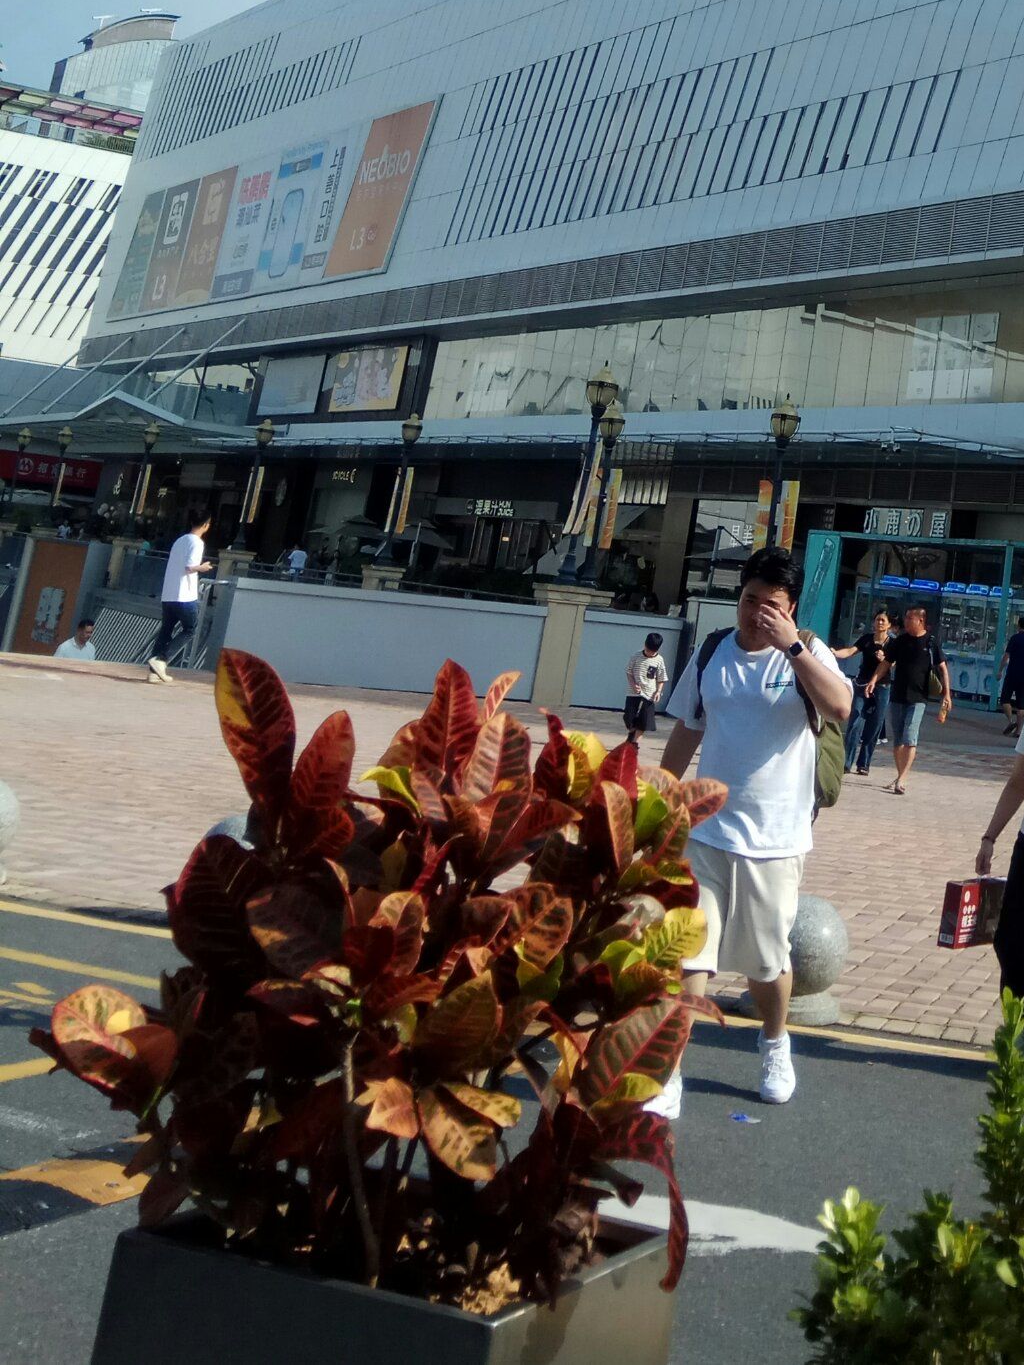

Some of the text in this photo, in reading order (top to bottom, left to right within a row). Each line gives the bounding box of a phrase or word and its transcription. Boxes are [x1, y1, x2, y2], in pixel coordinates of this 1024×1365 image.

[359, 147, 411, 185] NEOBIO
[349, 226, 365, 251] L3
[151, 274, 167, 301] L3
[863, 507, 947, 538] 小鹿の屋
